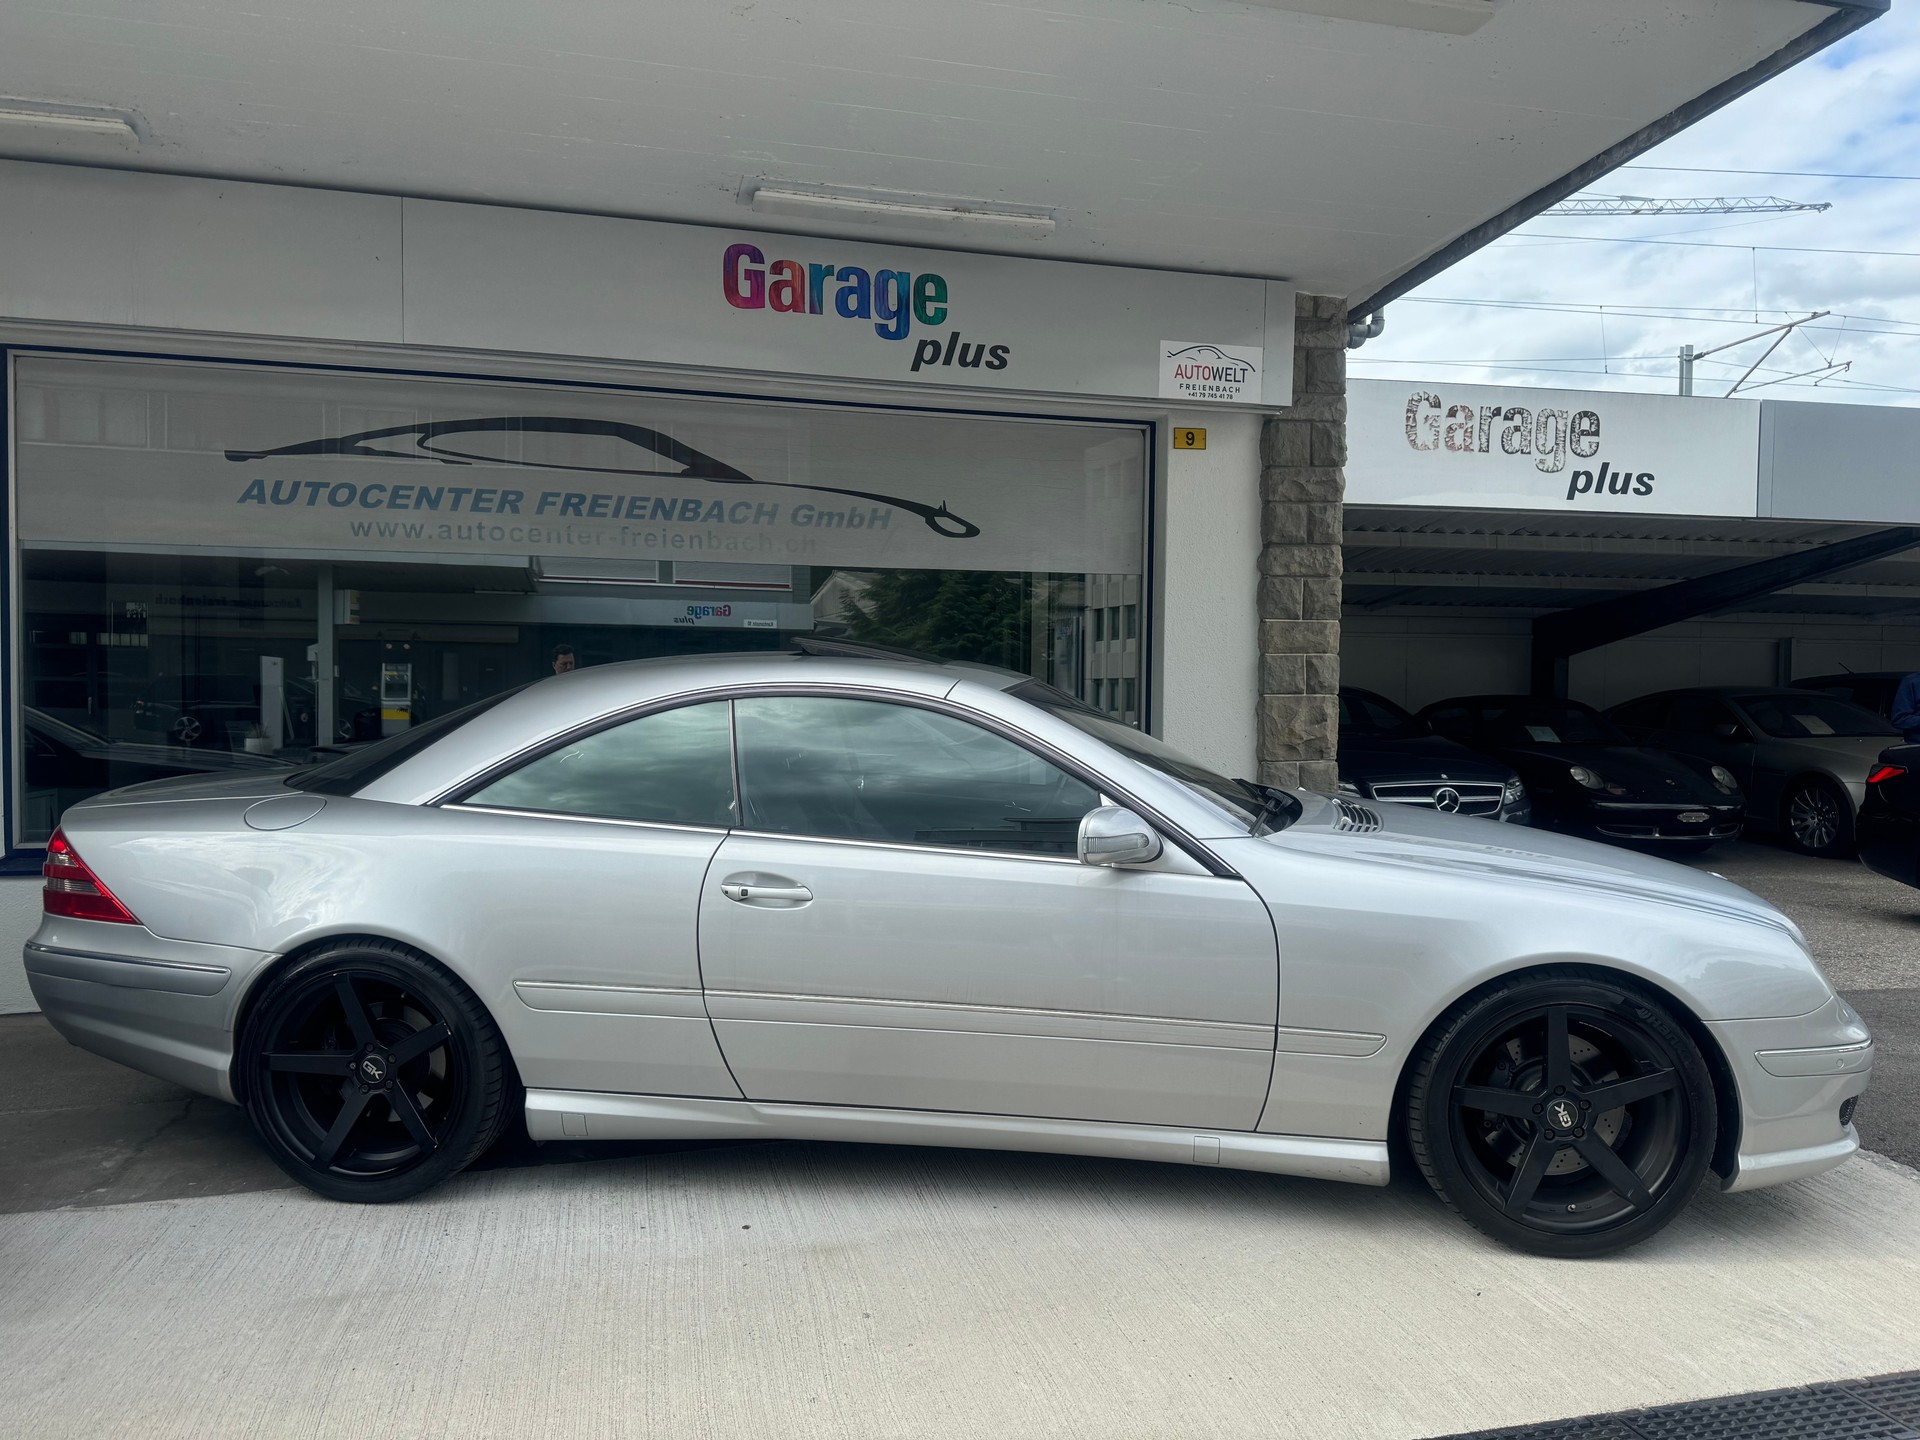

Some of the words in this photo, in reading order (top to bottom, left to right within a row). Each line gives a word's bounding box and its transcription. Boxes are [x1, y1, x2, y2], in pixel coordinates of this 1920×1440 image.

[723, 243, 948, 341] Garage
[910, 331, 1011, 372] plus
[1174, 363, 1249, 384] AUTOWELT
[1179, 383, 1241, 394] FREIENBACH
[1185, 431, 1196, 446] 9
[1405, 390, 1600, 474] Garage
[1566, 461, 1656, 501] plus
[237, 478, 525, 515] AUTOCENTER
[535, 491, 779, 526] FREIENBACH
[790, 503, 892, 530] GmbH
[350, 520, 817, 554] www.autocenter-freienbach.ch
